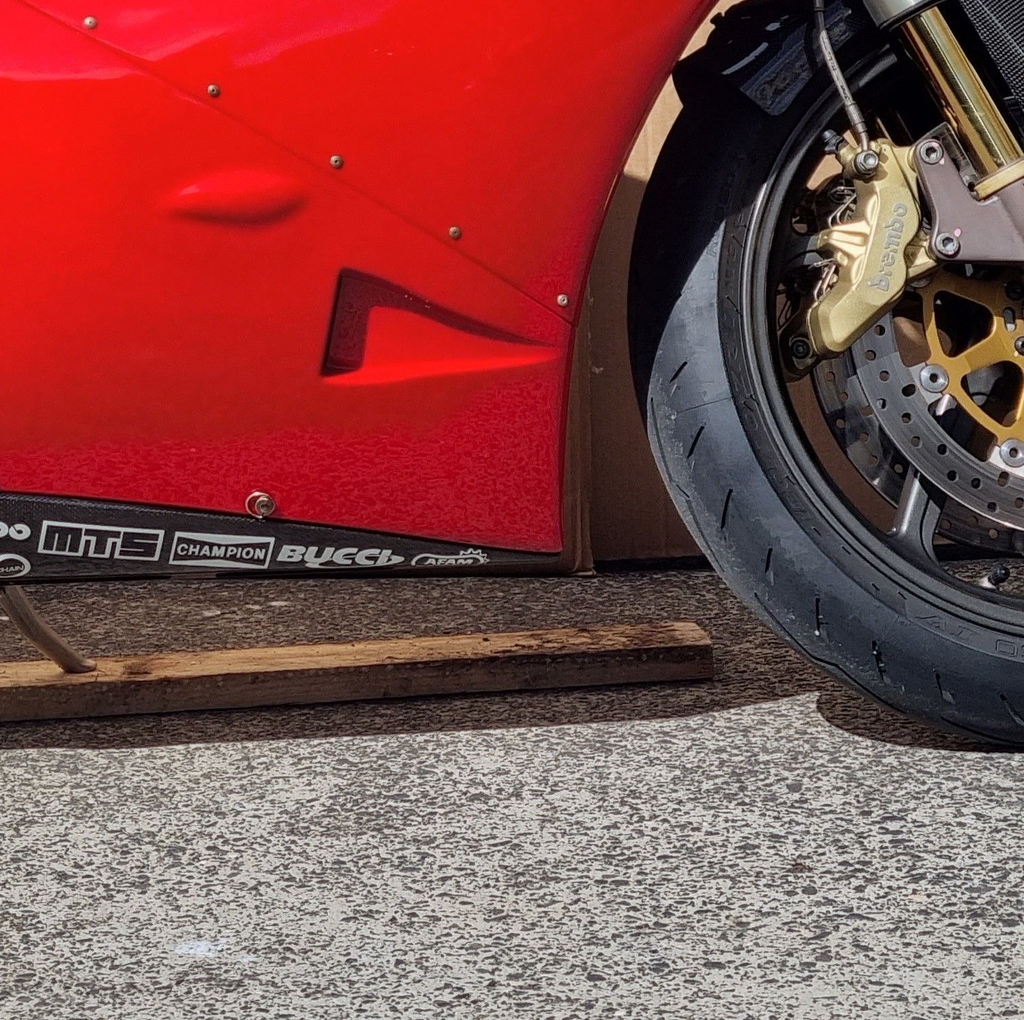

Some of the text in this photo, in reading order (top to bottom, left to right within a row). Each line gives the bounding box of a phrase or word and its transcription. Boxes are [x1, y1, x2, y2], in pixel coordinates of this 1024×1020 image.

[867, 203, 908, 293] brembo
[38, 520, 165, 561] MTS
[177, 543, 266, 561] CHAMPION
[424, 558, 474, 566] AFAM
